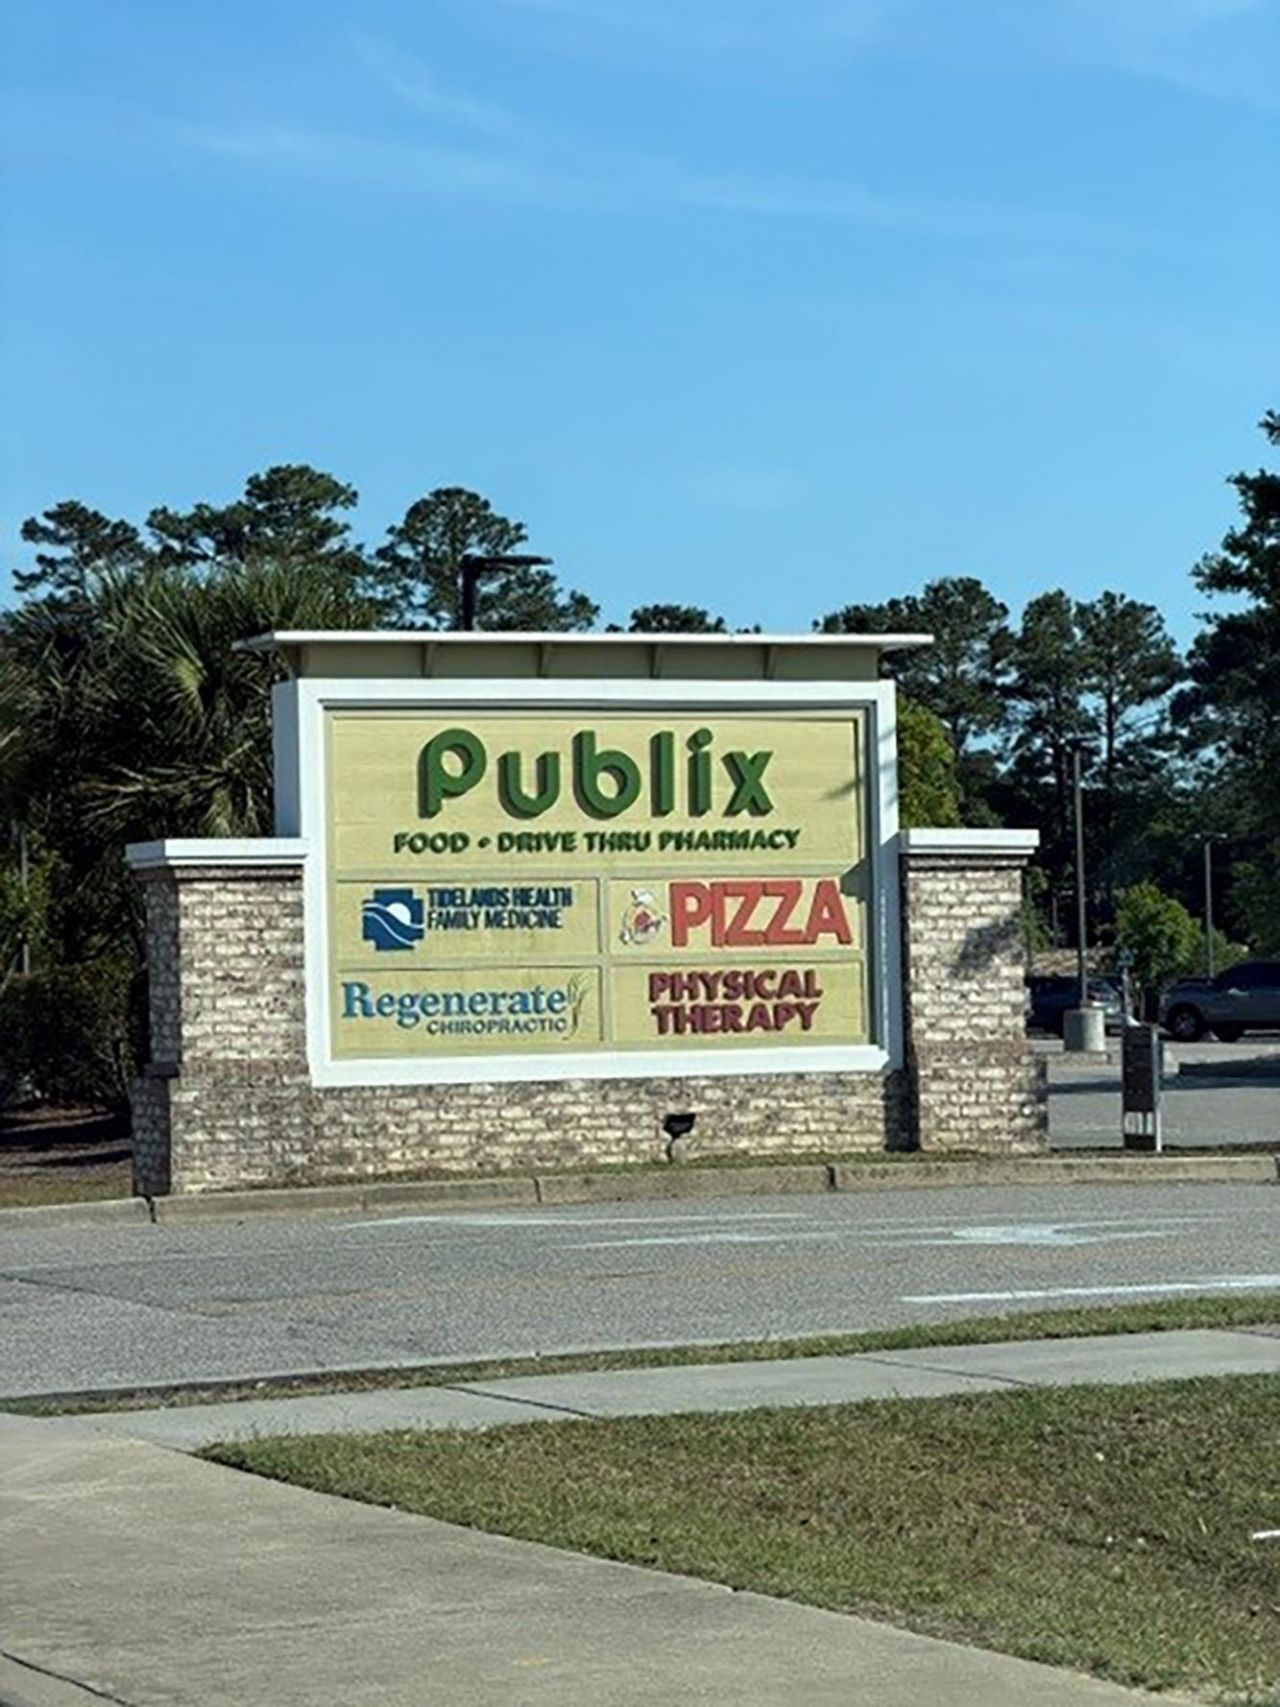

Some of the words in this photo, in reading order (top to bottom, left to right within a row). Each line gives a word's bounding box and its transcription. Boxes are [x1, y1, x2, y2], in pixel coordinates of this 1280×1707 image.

[417, 728, 774, 820] Publix
[394, 832, 470, 854] FOOD
[498, 831, 577, 853] DRIVE
[584, 831, 652, 852] THRU
[659, 829, 801, 851] PHARMACY
[427, 888, 510, 908] TIDELANDS
[512, 887, 573, 907] HEALTH
[669, 879, 853, 948] PIZZA
[428, 910, 482, 930] FAMILY
[485, 909, 563, 929] MEDICINE
[649, 969, 824, 1002] PHYSICAL
[341, 981, 568, 1029] Regenerate
[650, 1002, 820, 1035] THERAPY
[426, 1017, 568, 1035] CHIROPRACTIC
